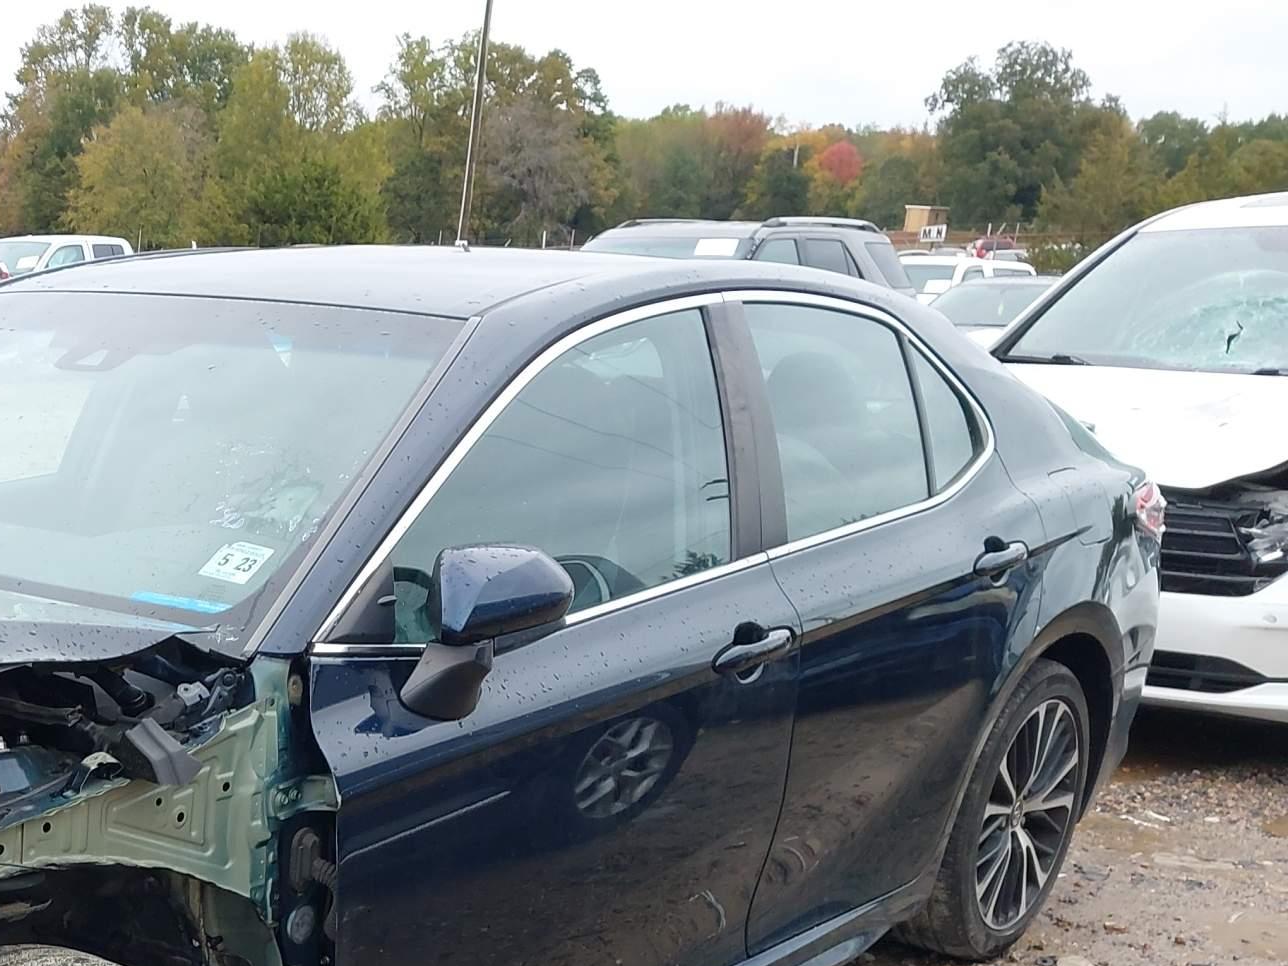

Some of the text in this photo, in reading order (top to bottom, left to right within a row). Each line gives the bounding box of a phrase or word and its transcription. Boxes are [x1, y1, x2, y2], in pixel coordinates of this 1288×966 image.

[922, 227, 943, 239] M N
[218, 553, 257, 572] 5 23
